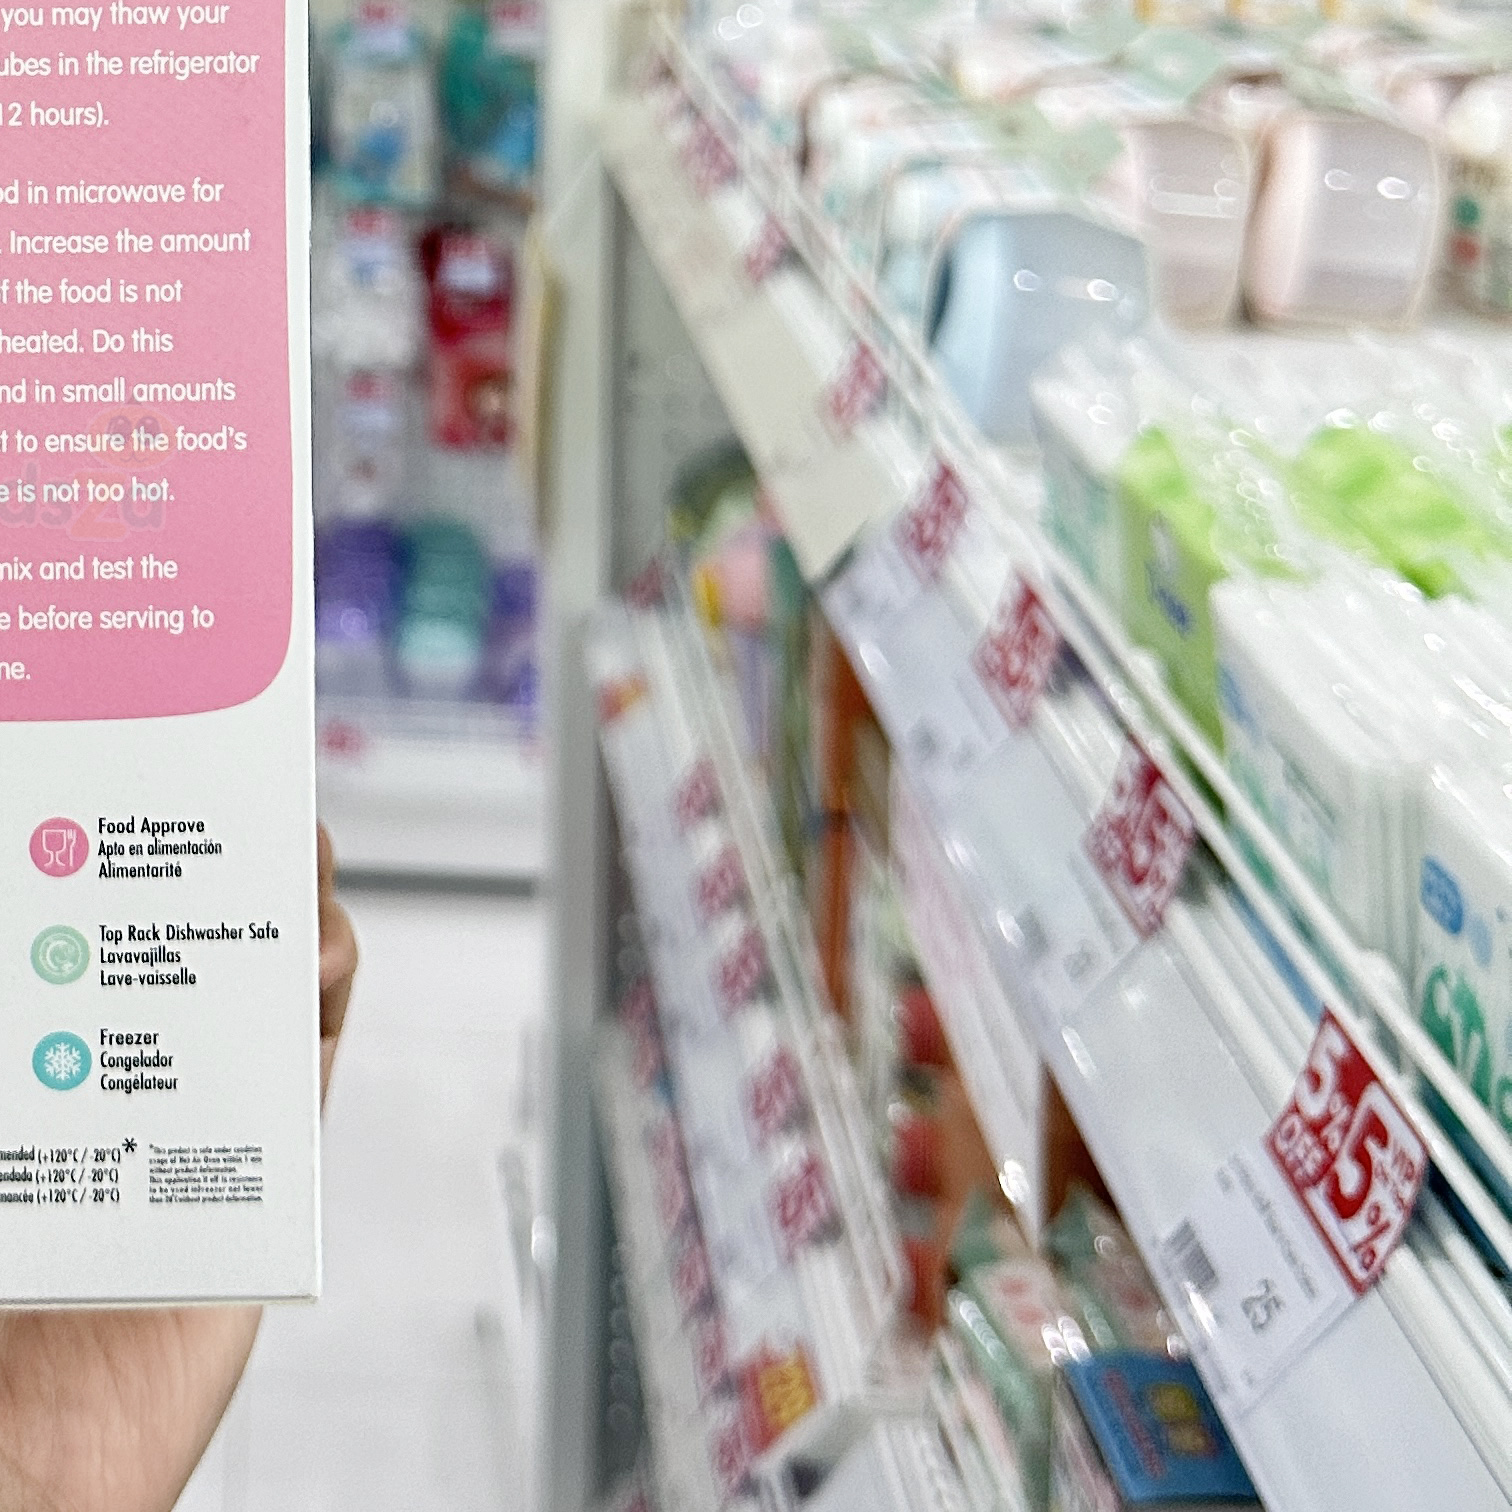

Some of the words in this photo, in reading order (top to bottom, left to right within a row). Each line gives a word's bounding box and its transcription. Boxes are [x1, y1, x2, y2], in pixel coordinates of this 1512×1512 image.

[59, 52, 79, 75] in
[86, 50, 123, 75] the
[130, 49, 260, 80] refrigerator
[31, 101, 108, 127] hours).
[28, 181, 48, 204] in
[56, 180, 185, 203] microwave
[192, 177, 224, 202] for
[11, 231, 108, 254] Increase
[115, 228, 153, 252] the
[161, 228, 251, 252] amount
[93, 330, 124, 352] Do
[131, 327, 173, 352] this
[35, 380, 55, 402] in
[63, 377, 125, 402] small
[133, 378, 235, 402] amounts
[15, 430, 38, 452] to
[45, 434, 124, 452] ensure
[131, 426, 168, 452] the
[175, 425, 247, 450] food's
[17, 479, 35, 502] is
[43, 479, 80, 502] not
[87, 479, 124, 502] too
[132, 476, 174, 501] hot.
[19, 605, 92, 630] before
[100, 605, 184, 634] serving
[191, 605, 214, 628] to
[99, 816, 134, 834] Food
[141, 817, 204, 838] Approve
[98, 840, 124, 861] Apto
[129, 844, 143, 855] en
[148, 838, 221, 855] alimentación
[99, 925, 122, 945] Top
[128, 923, 160, 941] Rack
[166, 922, 243, 940] Dishwasher
[249, 921, 278, 939] Safe
[101, 967, 196, 986] Lave-vaisselle
[101, 1029, 159, 1045] Freezer
[101, 1049, 173, 1071] Congelador
